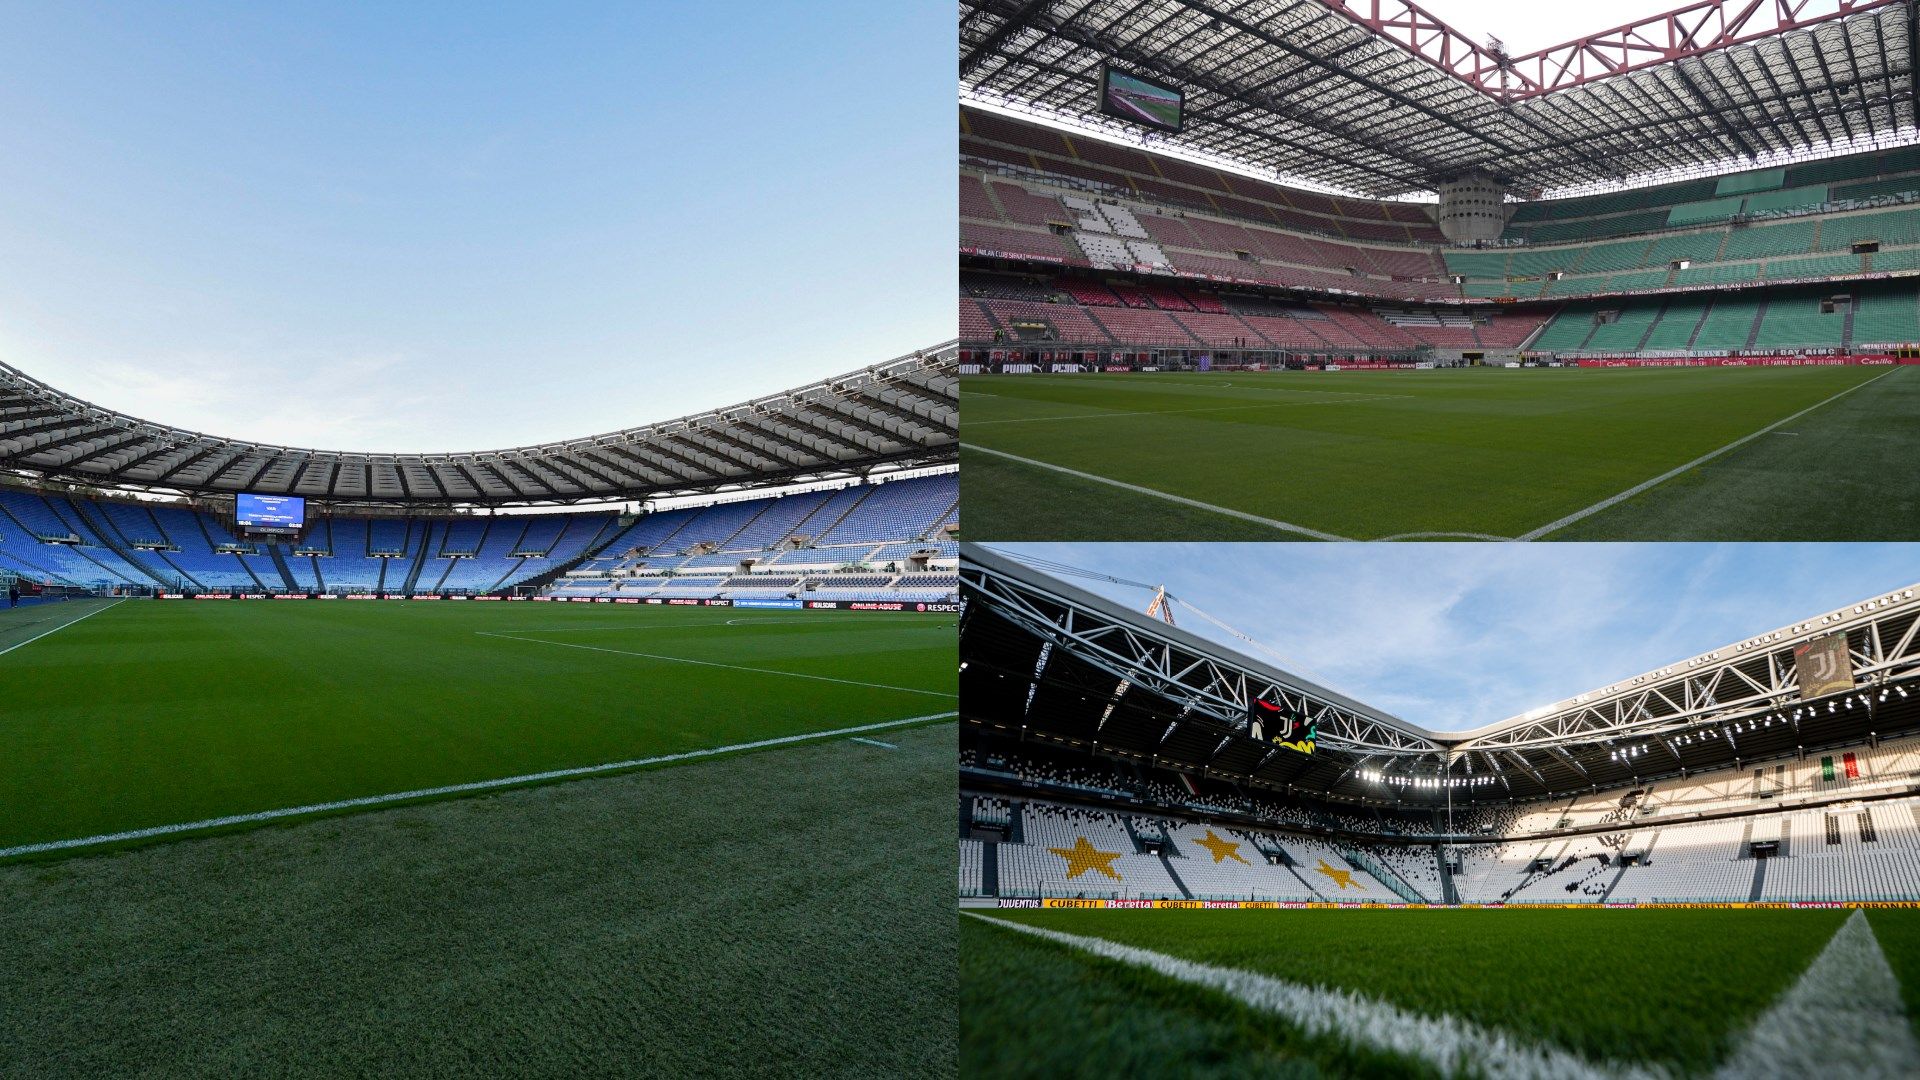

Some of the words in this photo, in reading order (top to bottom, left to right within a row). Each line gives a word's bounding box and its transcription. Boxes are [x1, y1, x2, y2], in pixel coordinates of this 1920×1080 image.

[1003, 364, 1032, 373] PUMA
[999, 899, 1041, 908] JUVENTUS
[1050, 900, 1097, 908] CUBETTI
[1109, 899, 1151, 908] Beretta
